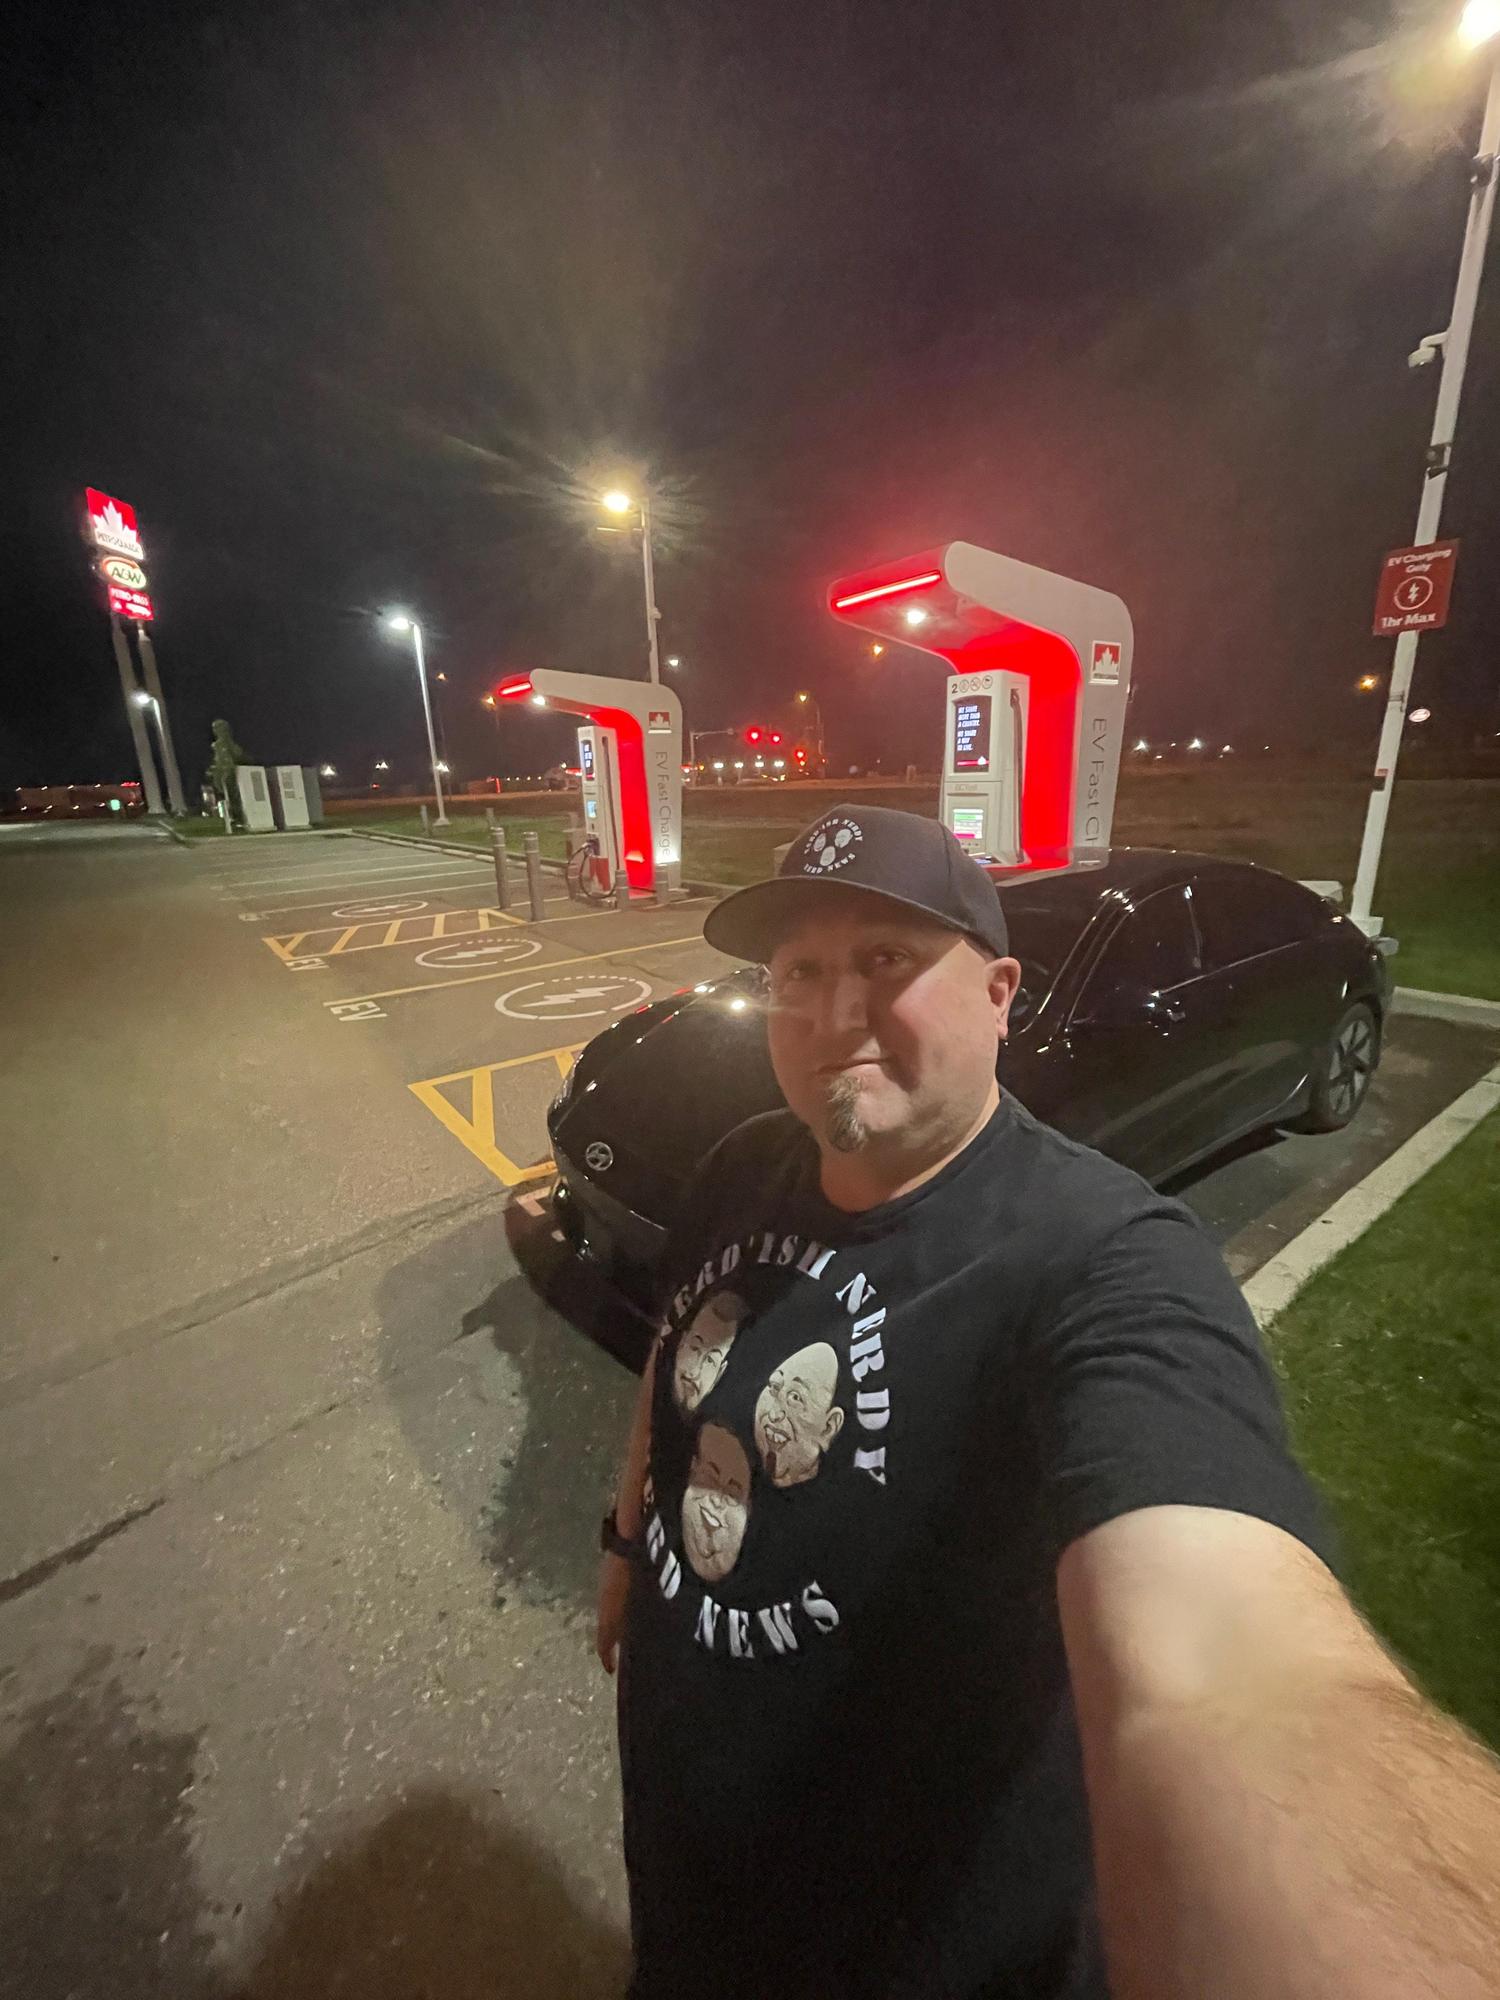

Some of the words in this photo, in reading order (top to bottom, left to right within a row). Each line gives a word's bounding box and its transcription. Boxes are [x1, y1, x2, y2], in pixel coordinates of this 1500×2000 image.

[112, 566, 142, 585] A&W
[1404, 613, 1437, 625] Max
[951, 683, 959, 694] 2
[1092, 718, 1107, 752] EV
[655, 751, 668, 770] EV
[656, 774, 670, 801] Fast
[1088, 760, 1105, 807] Fast
[658, 804, 672, 857] Charge
[330, 1000, 388, 1022] EV
[834, 1272, 891, 1486] NERDY
[694, 1579, 840, 1659] NEWS
